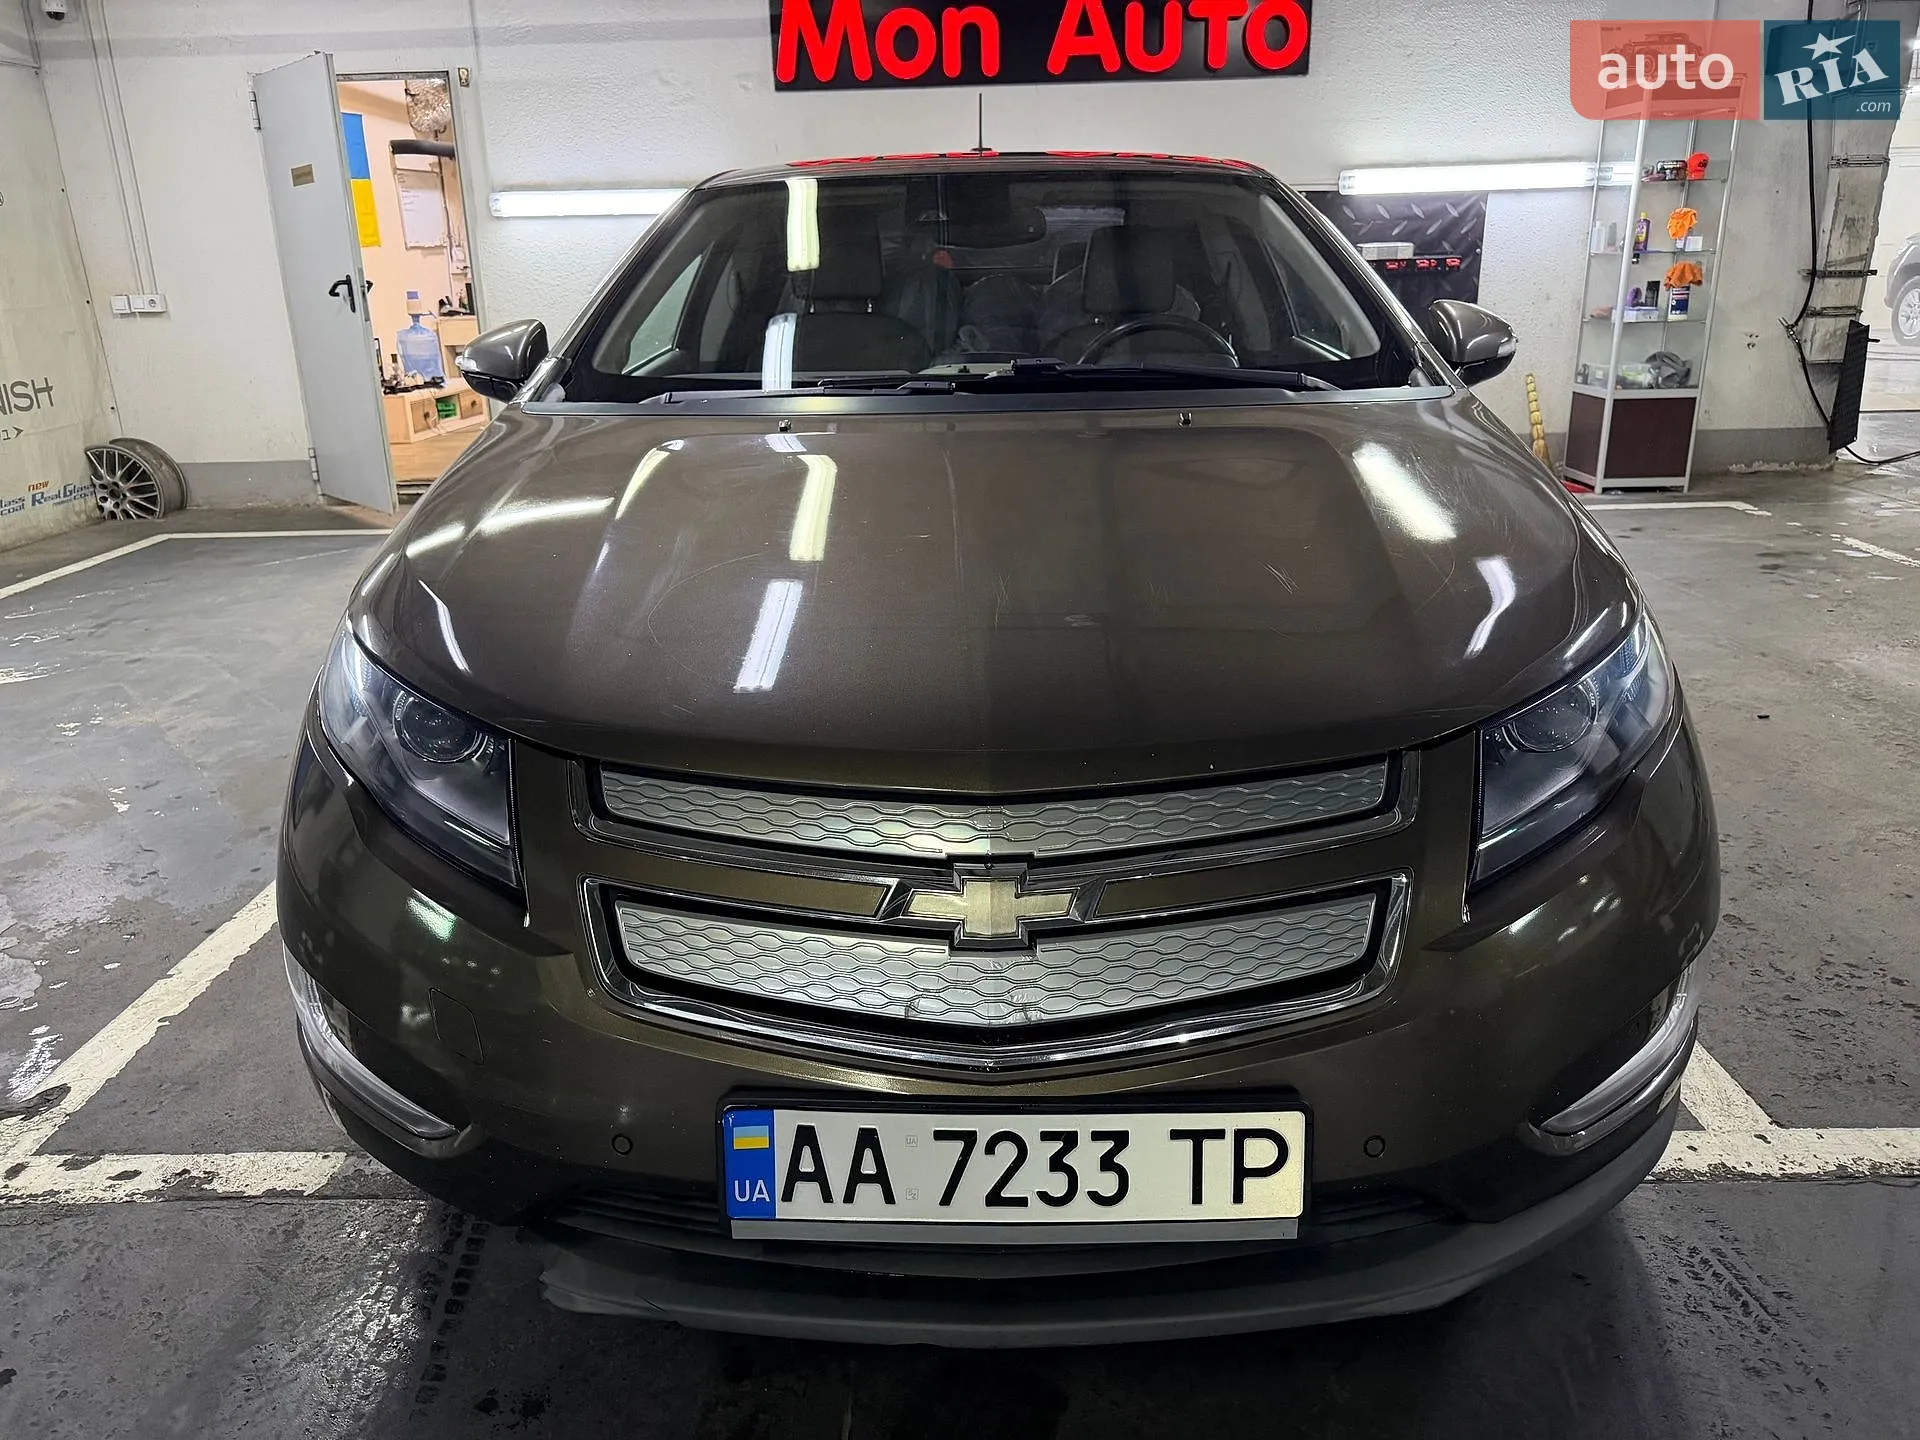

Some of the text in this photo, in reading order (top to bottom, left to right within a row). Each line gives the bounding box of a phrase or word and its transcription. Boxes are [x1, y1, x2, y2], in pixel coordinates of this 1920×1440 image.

[776, 0, 1000, 83] Mon
[28, 481, 49, 492] new
[734, 1124, 1290, 1207] UA AA 7233 TP
